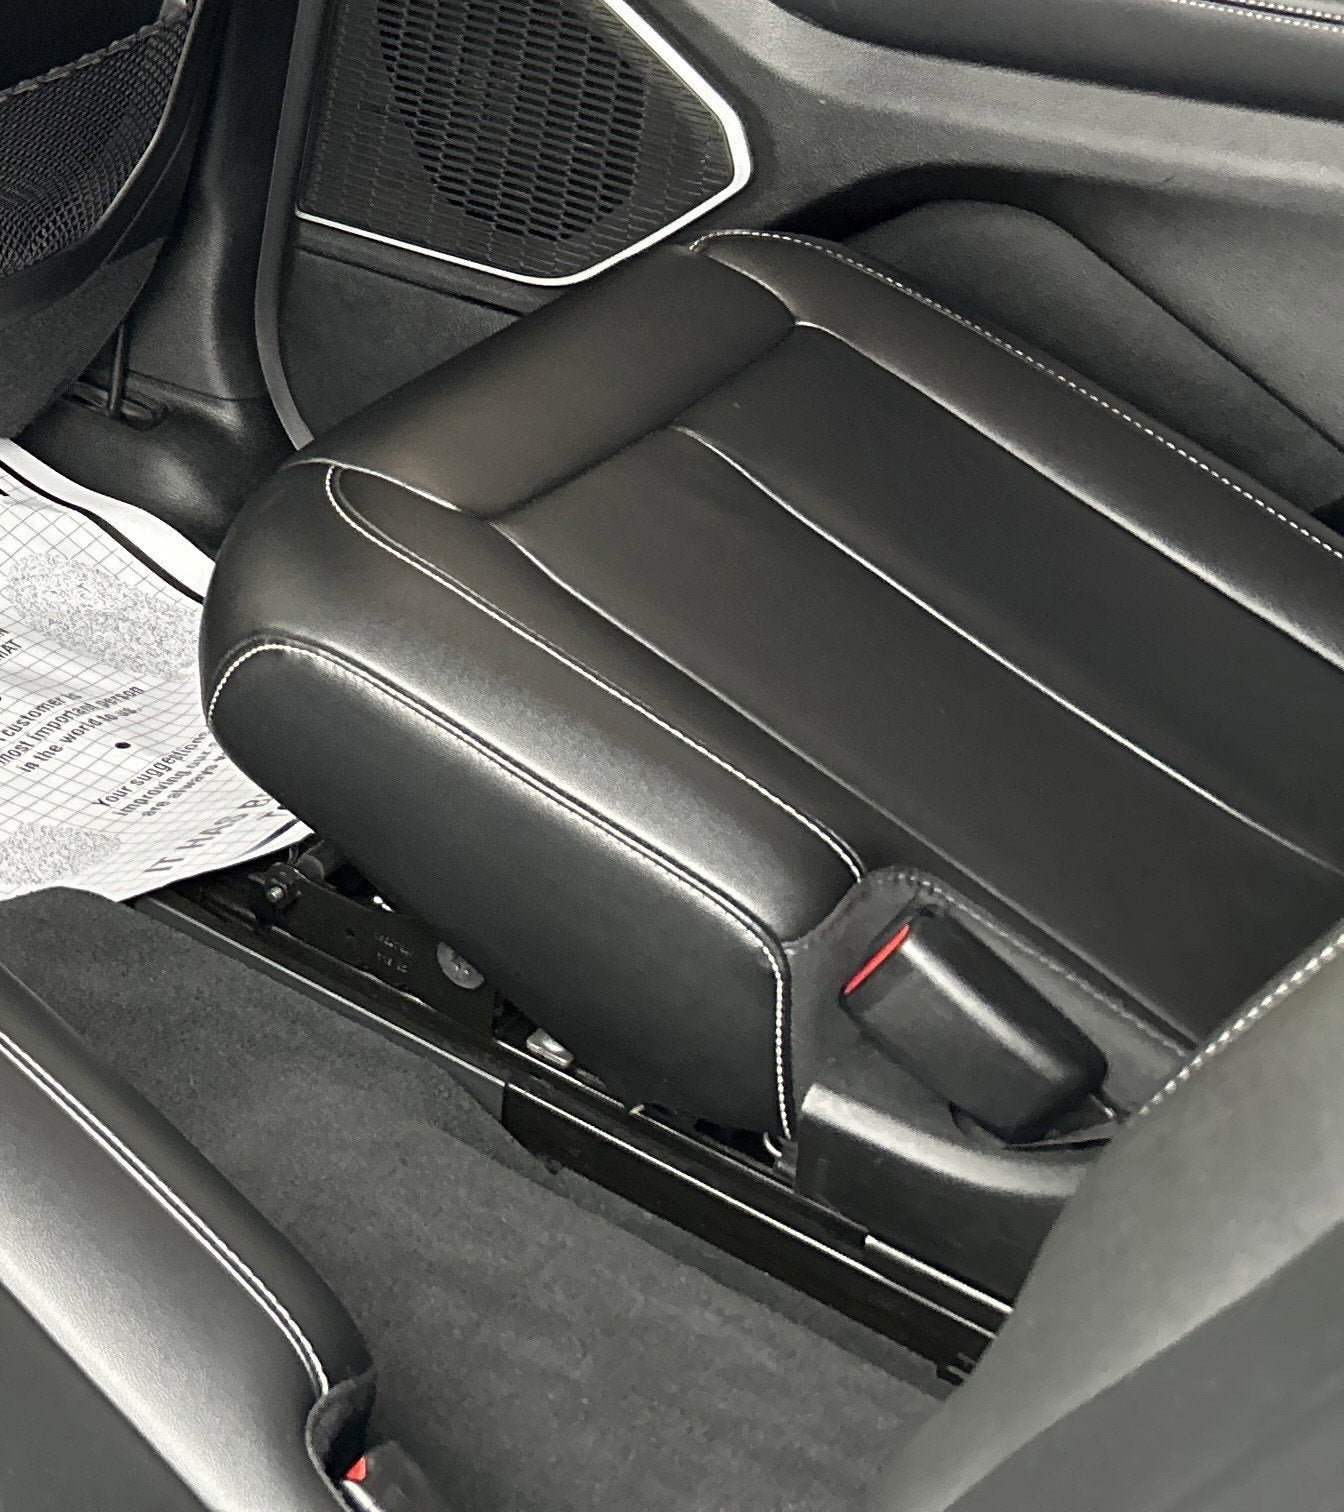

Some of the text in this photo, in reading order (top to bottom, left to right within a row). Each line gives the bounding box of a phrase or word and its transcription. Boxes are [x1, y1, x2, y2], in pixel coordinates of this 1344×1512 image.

[2, 696, 67, 738] customer
[63, 691, 83, 701] is
[26, 701, 101, 742] important
[95, 686, 144, 710] person
[16, 761, 40, 773] in
[33, 743, 64, 763] the
[59, 716, 104, 744] world
[97, 711, 119, 723] to
[91, 786, 133, 809] Your
[113, 770, 192, 817] improving
[141, 764, 219, 818] are always
[144, 856, 185, 873] IT
[176, 813, 249, 850] HAS
